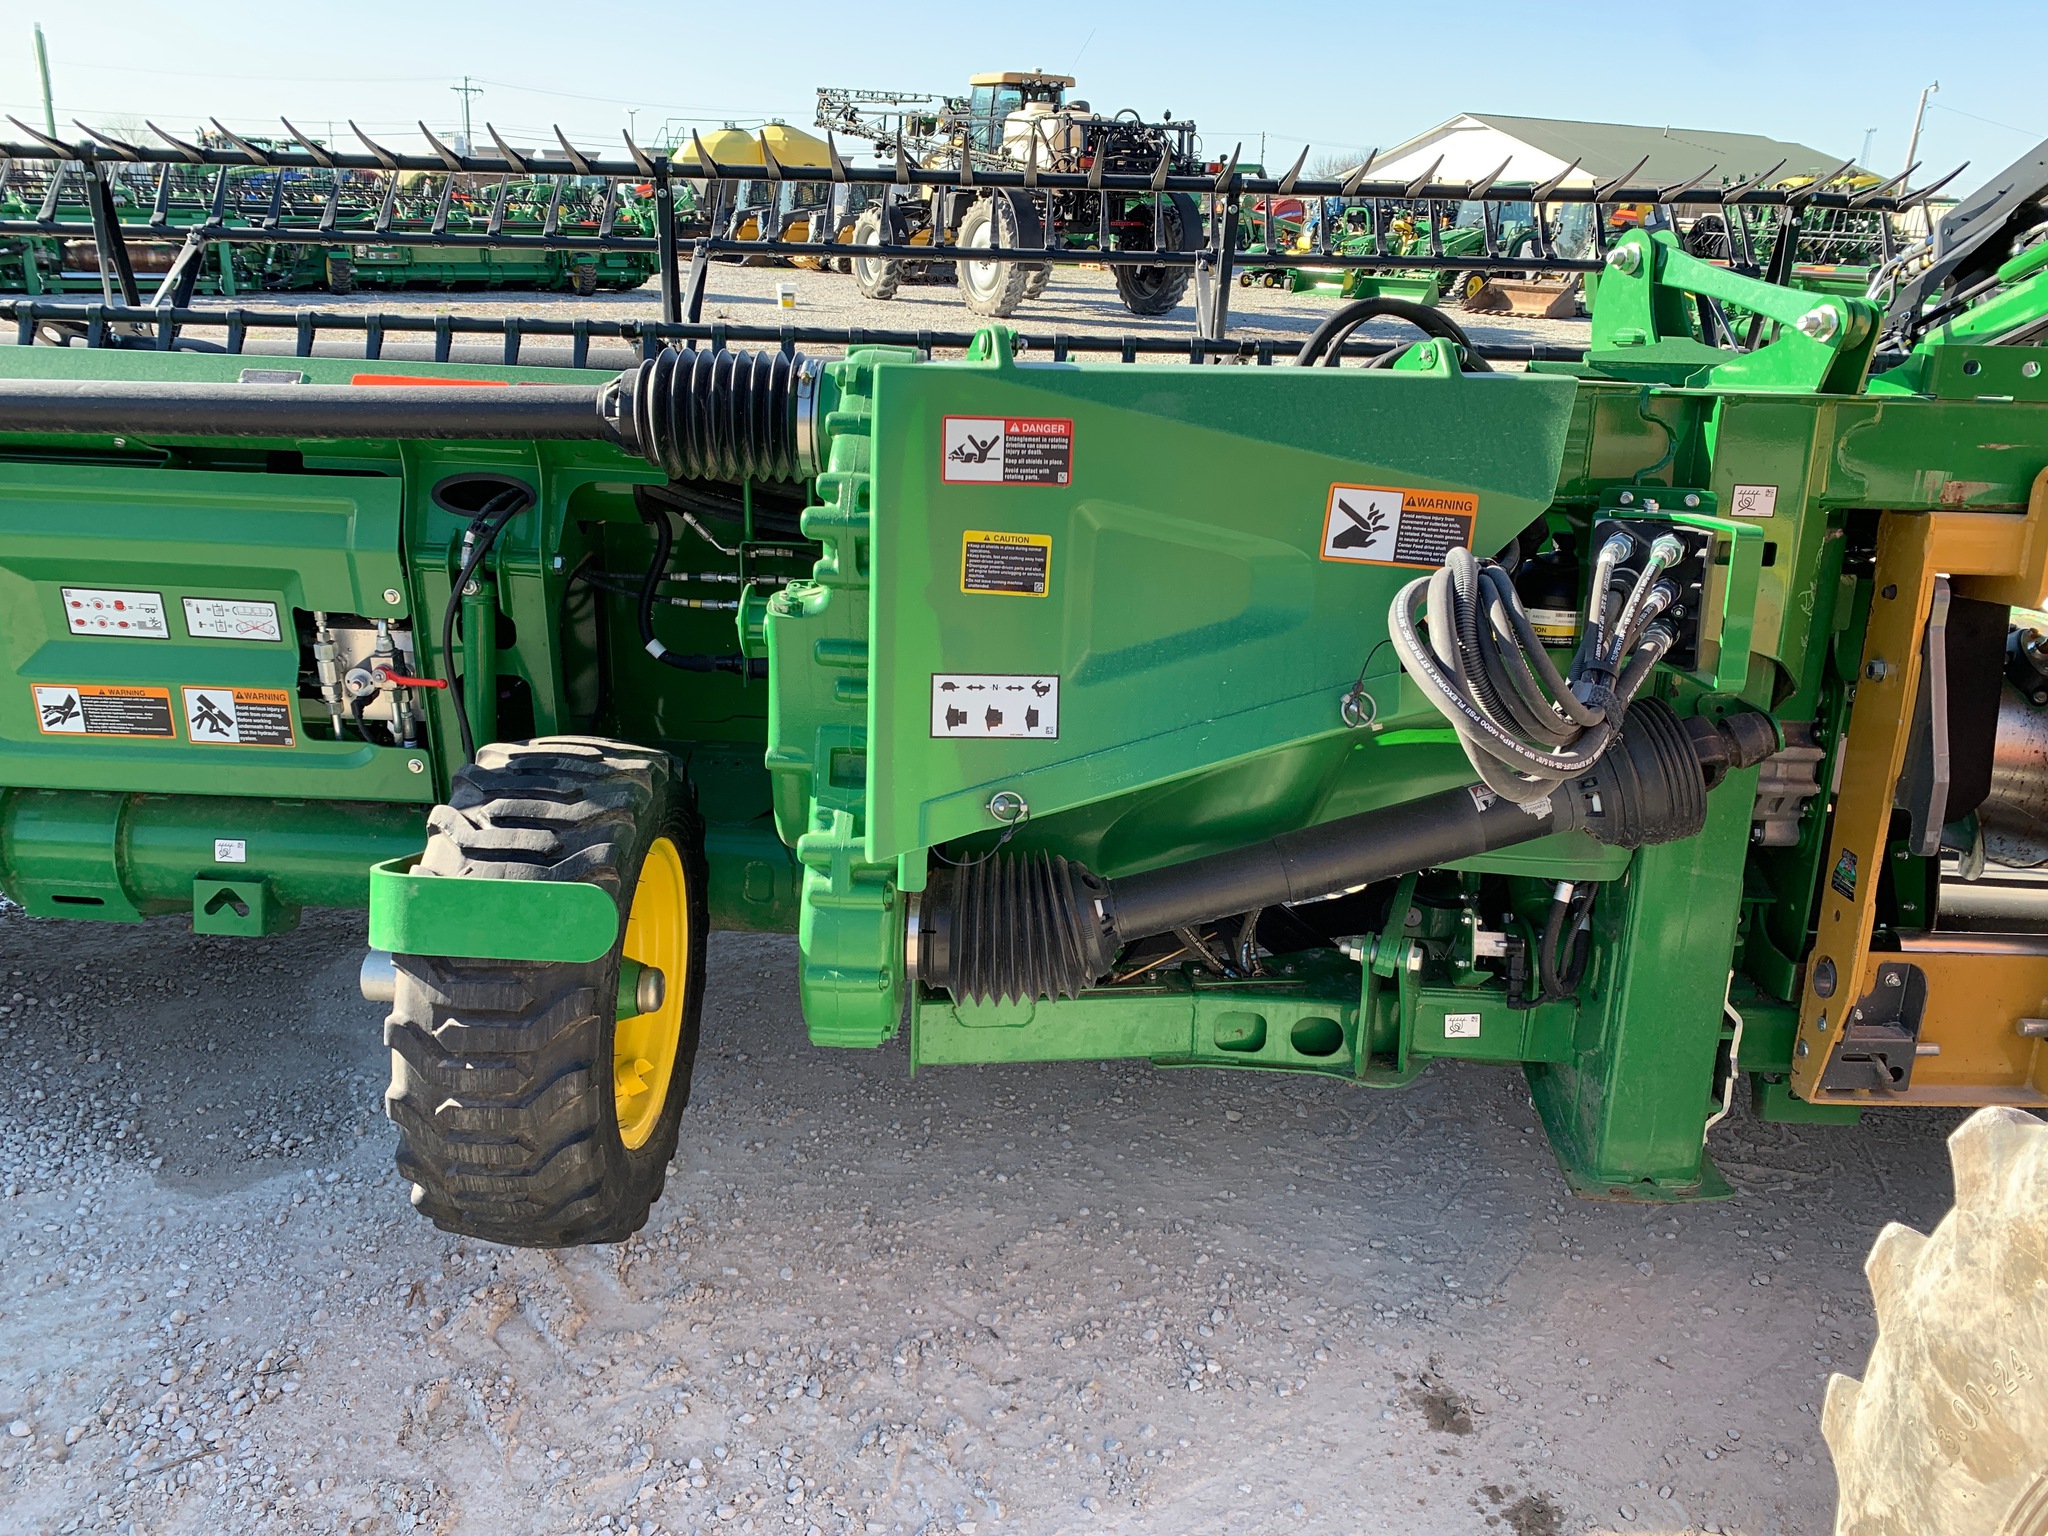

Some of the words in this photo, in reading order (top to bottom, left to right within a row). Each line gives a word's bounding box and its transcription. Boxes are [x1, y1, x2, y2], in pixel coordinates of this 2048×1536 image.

[1022, 423, 1065, 433] DANGER
[1418, 497, 1473, 511] WARNING
[994, 535, 1030, 543] CAUTION
[1611, 629, 1626, 660] SUPERTUFF
[1633, 593, 1641, 603] WP
[1640, 576, 1650, 587] MPa
[1413, 650, 1424, 659] EN
[1419, 657, 1430, 669] ST
[244, 692, 286, 701] WARNING
[1431, 672, 1466, 709] FLEXOPAK
[1464, 706, 1481, 722] PSI)
[1479, 719, 1499, 737] (4000
[1498, 733, 1515, 748] MPa
[1523, 749, 1536, 760] WP
